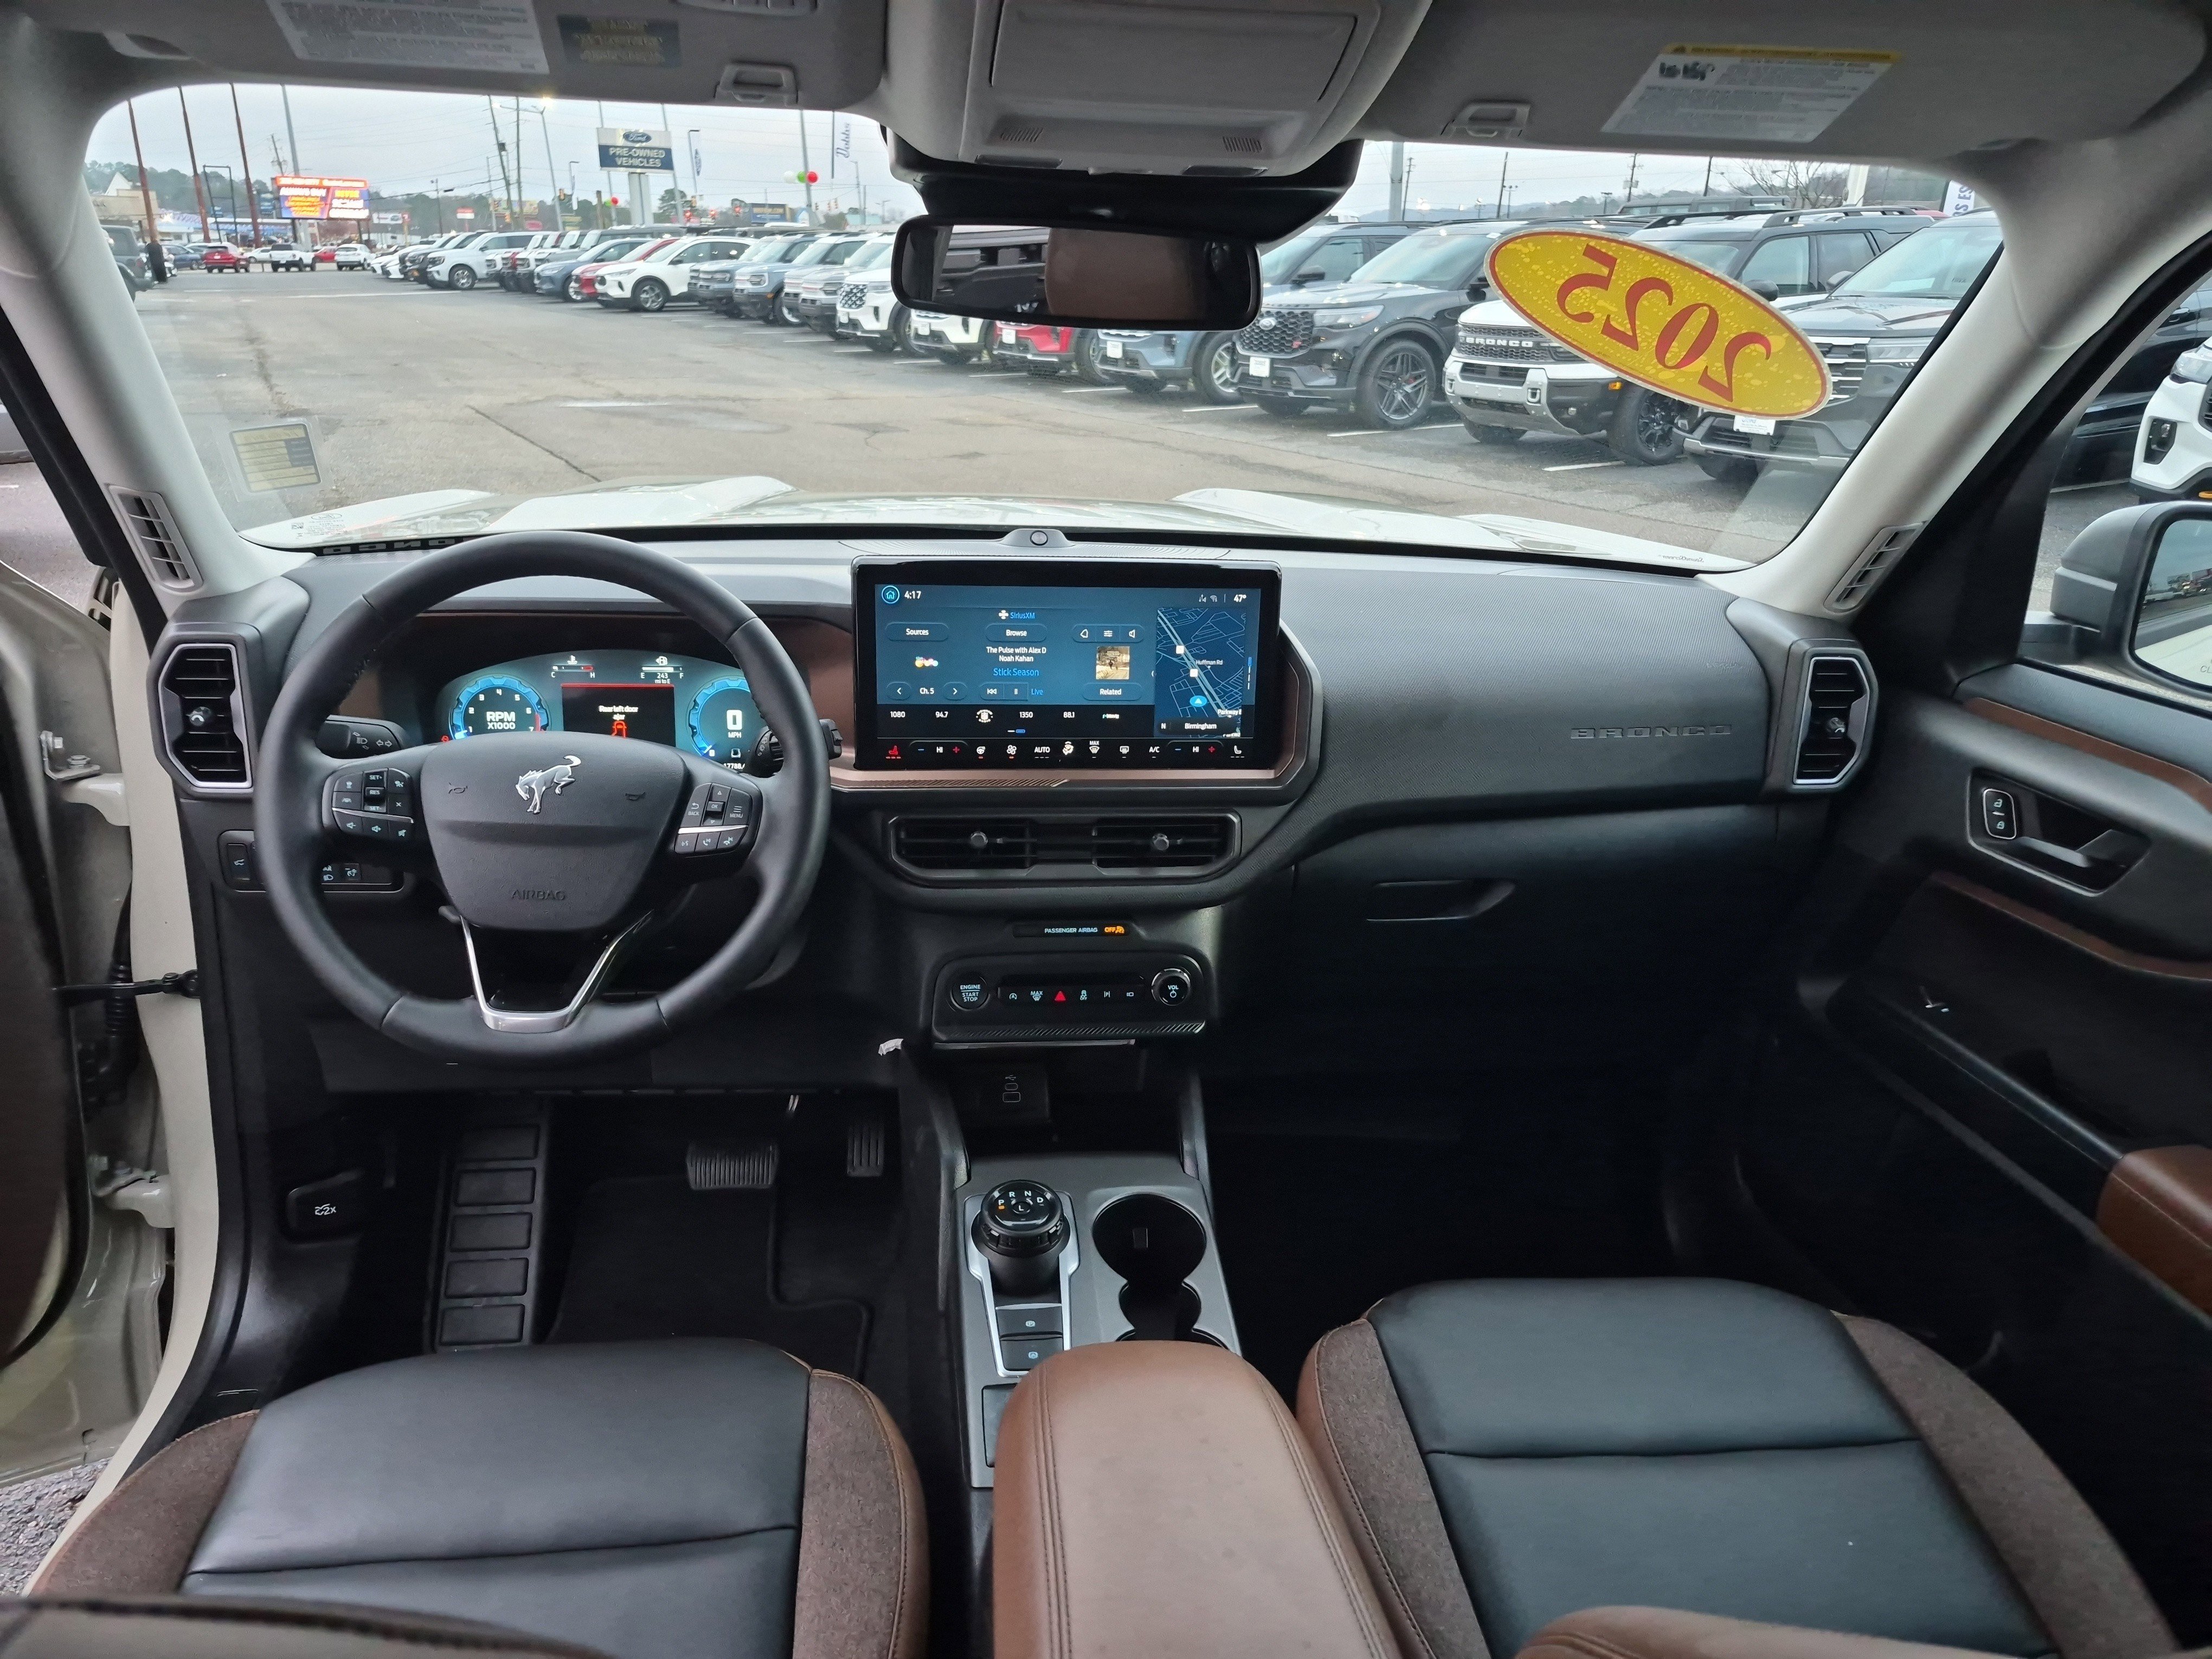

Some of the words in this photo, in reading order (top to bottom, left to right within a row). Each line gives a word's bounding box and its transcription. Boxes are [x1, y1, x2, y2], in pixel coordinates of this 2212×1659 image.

[608, 147, 666, 158] PRE-OWNED
[615, 157, 662, 168] VEHICLES
[1465, 337, 1534, 348] BRONCO
[904, 590, 922, 600] 4:17
[993, 668, 1012, 677] Stick
[1012, 668, 1039, 677] Season
[486, 711, 516, 722] RPM
[726, 710, 742, 730] 0
[1570, 725, 1732, 739] BRONCO
[511, 889, 565, 901] AIRBAG
